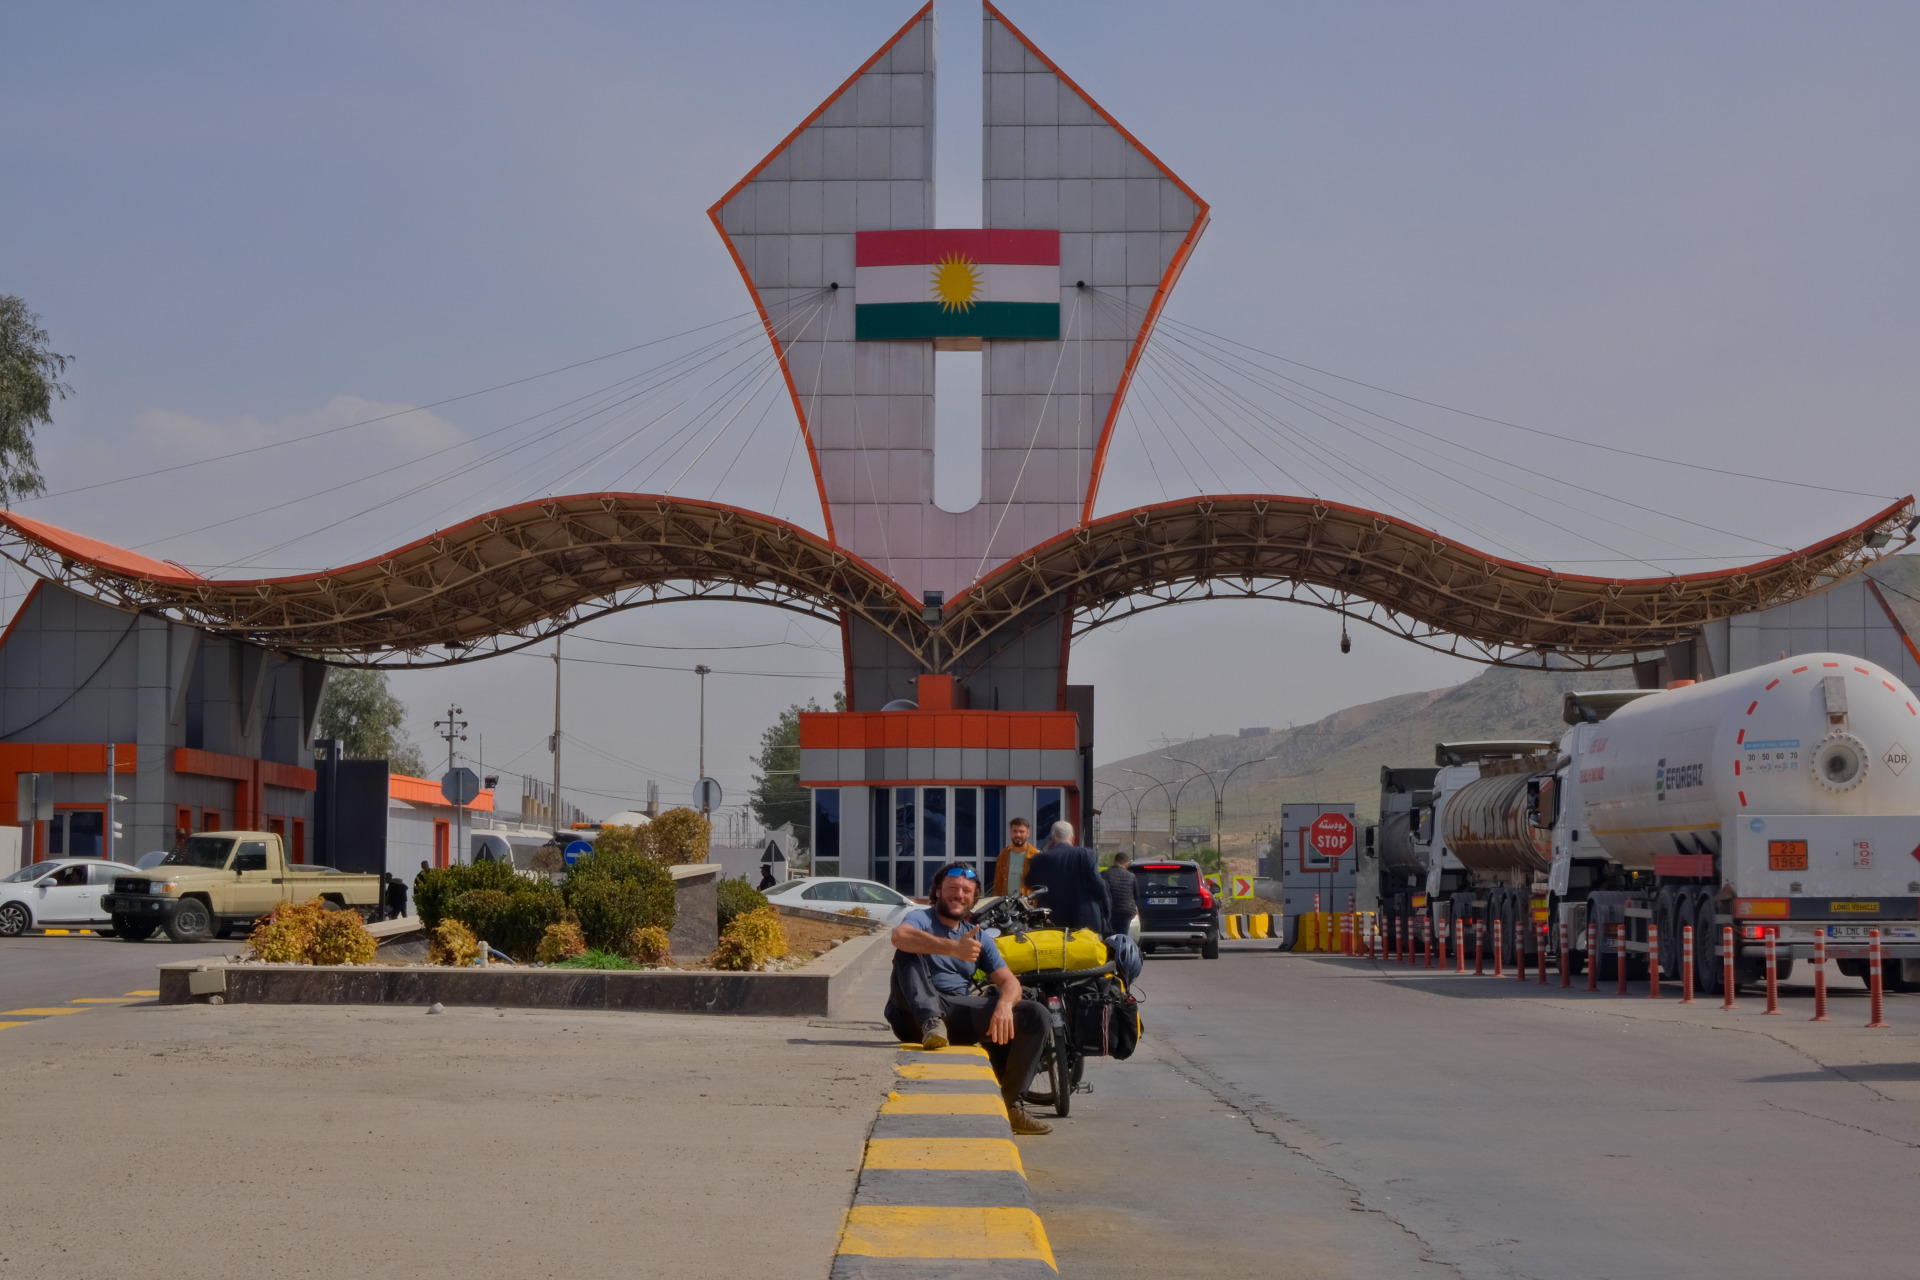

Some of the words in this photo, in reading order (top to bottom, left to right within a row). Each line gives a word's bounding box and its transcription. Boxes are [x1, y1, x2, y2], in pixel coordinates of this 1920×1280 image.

[1748, 753, 1756, 761] 30
[1762, 752, 1770, 761] 50
[1776, 752, 1785, 760] 60
[1790, 751, 1798, 760] 70
[1887, 754, 1908, 764] ADR
[1666, 763, 1704, 790] EFORGAZ
[1317, 835, 1347, 848] STOP
[1781, 843, 1796, 854] 23
[1859, 841, 1870, 866] BOS
[1774, 857, 1804, 868] 1965
[1833, 903, 1850, 911] LONG
[1851, 903, 1878, 911] VEHICLE
[1833, 927, 1842, 936] 34
[1846, 927, 1861, 936] CMC
